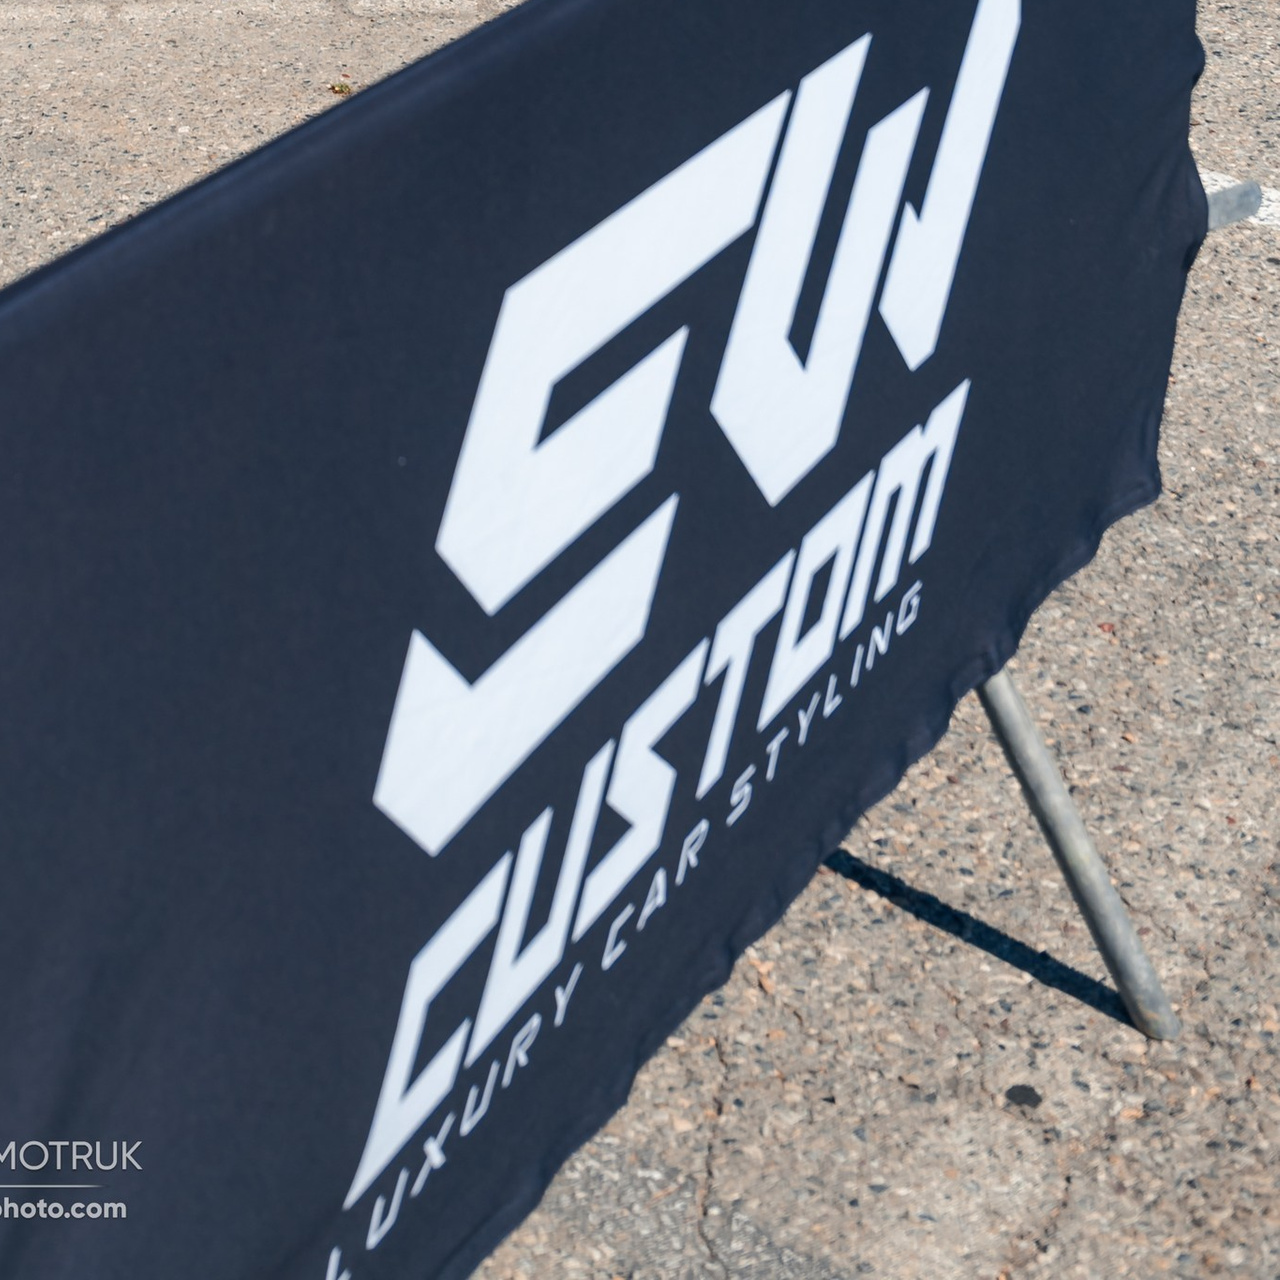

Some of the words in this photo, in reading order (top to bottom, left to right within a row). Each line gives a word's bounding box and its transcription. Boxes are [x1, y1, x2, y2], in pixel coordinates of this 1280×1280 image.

[343, 378, 971, 1212] CUSTOM
[602, 818, 709, 971] CAR
[726, 580, 923, 827] STYLING
